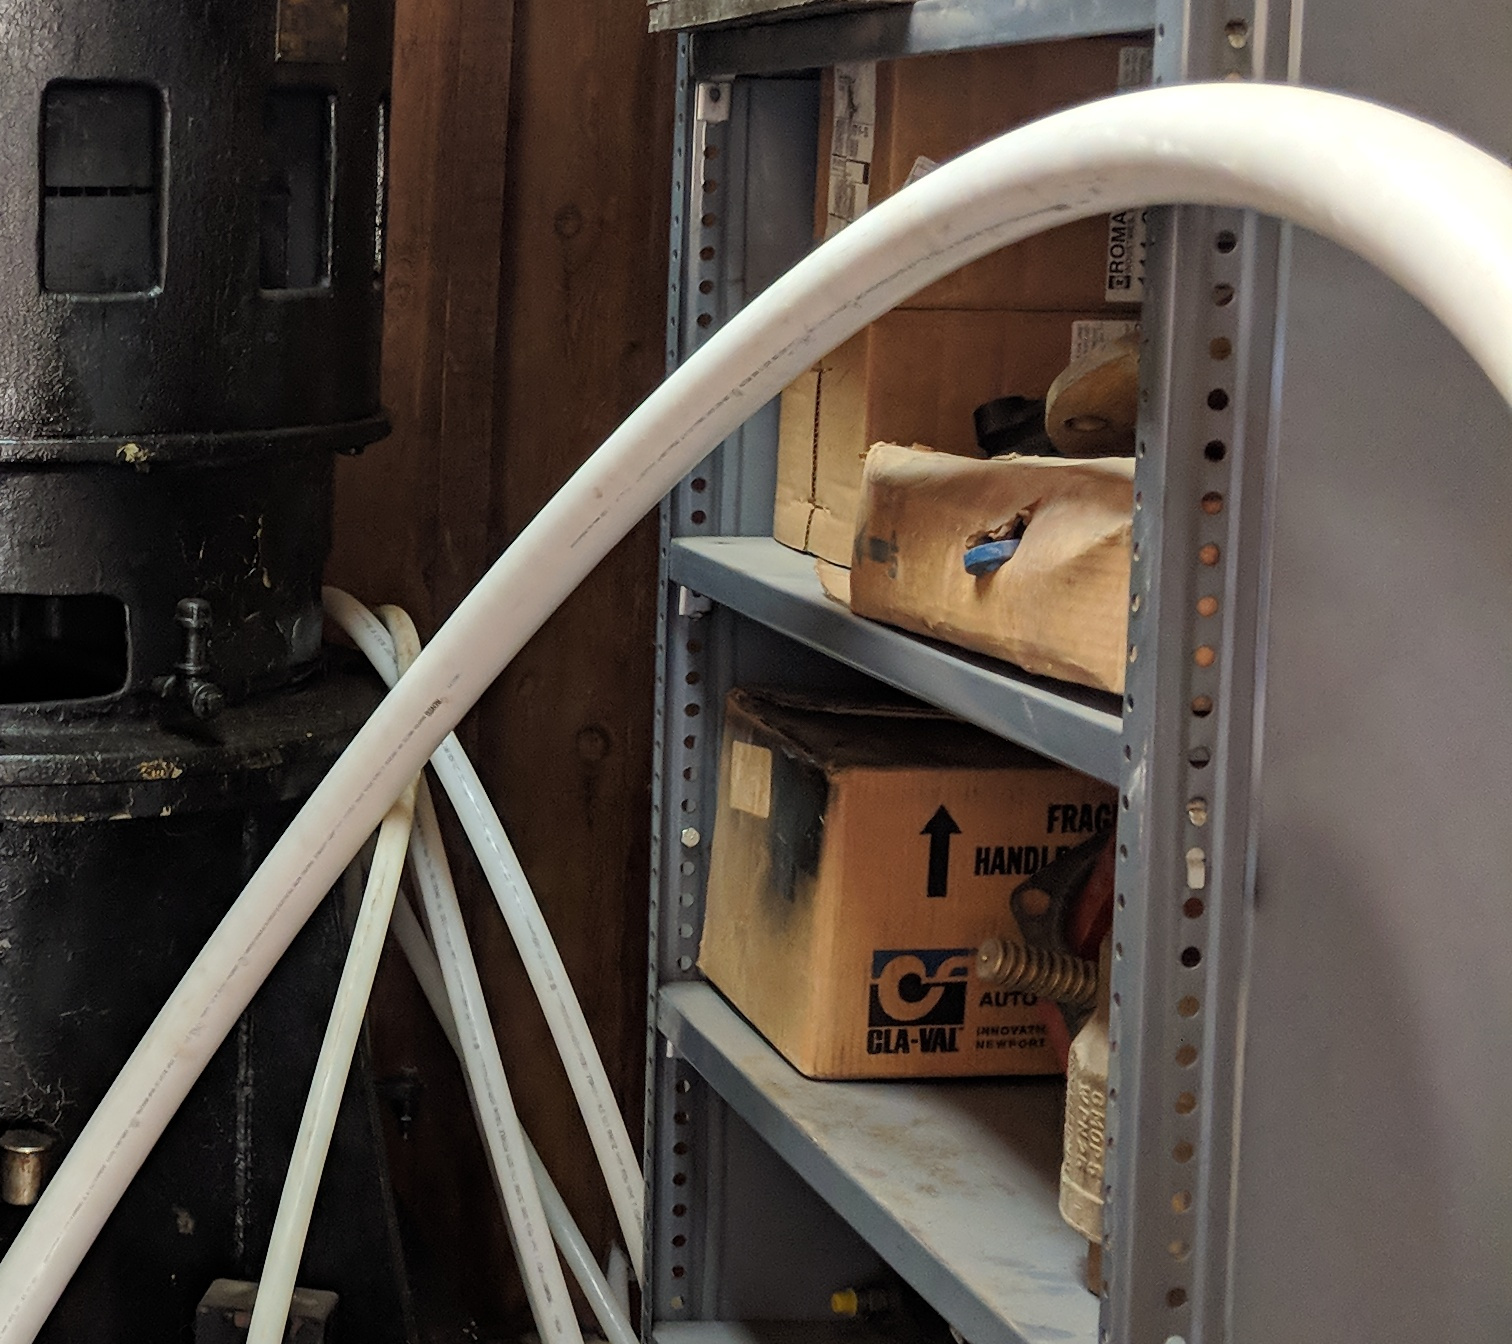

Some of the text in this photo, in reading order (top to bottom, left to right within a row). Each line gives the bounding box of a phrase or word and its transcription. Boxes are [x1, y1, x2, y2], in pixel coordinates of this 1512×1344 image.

[1109, 210, 1128, 274] ROMA
[1046, 803, 1115, 834] FRAG
[979, 990, 1038, 1008] AUTO
[867, 1028, 960, 1054] CLA-VAL
